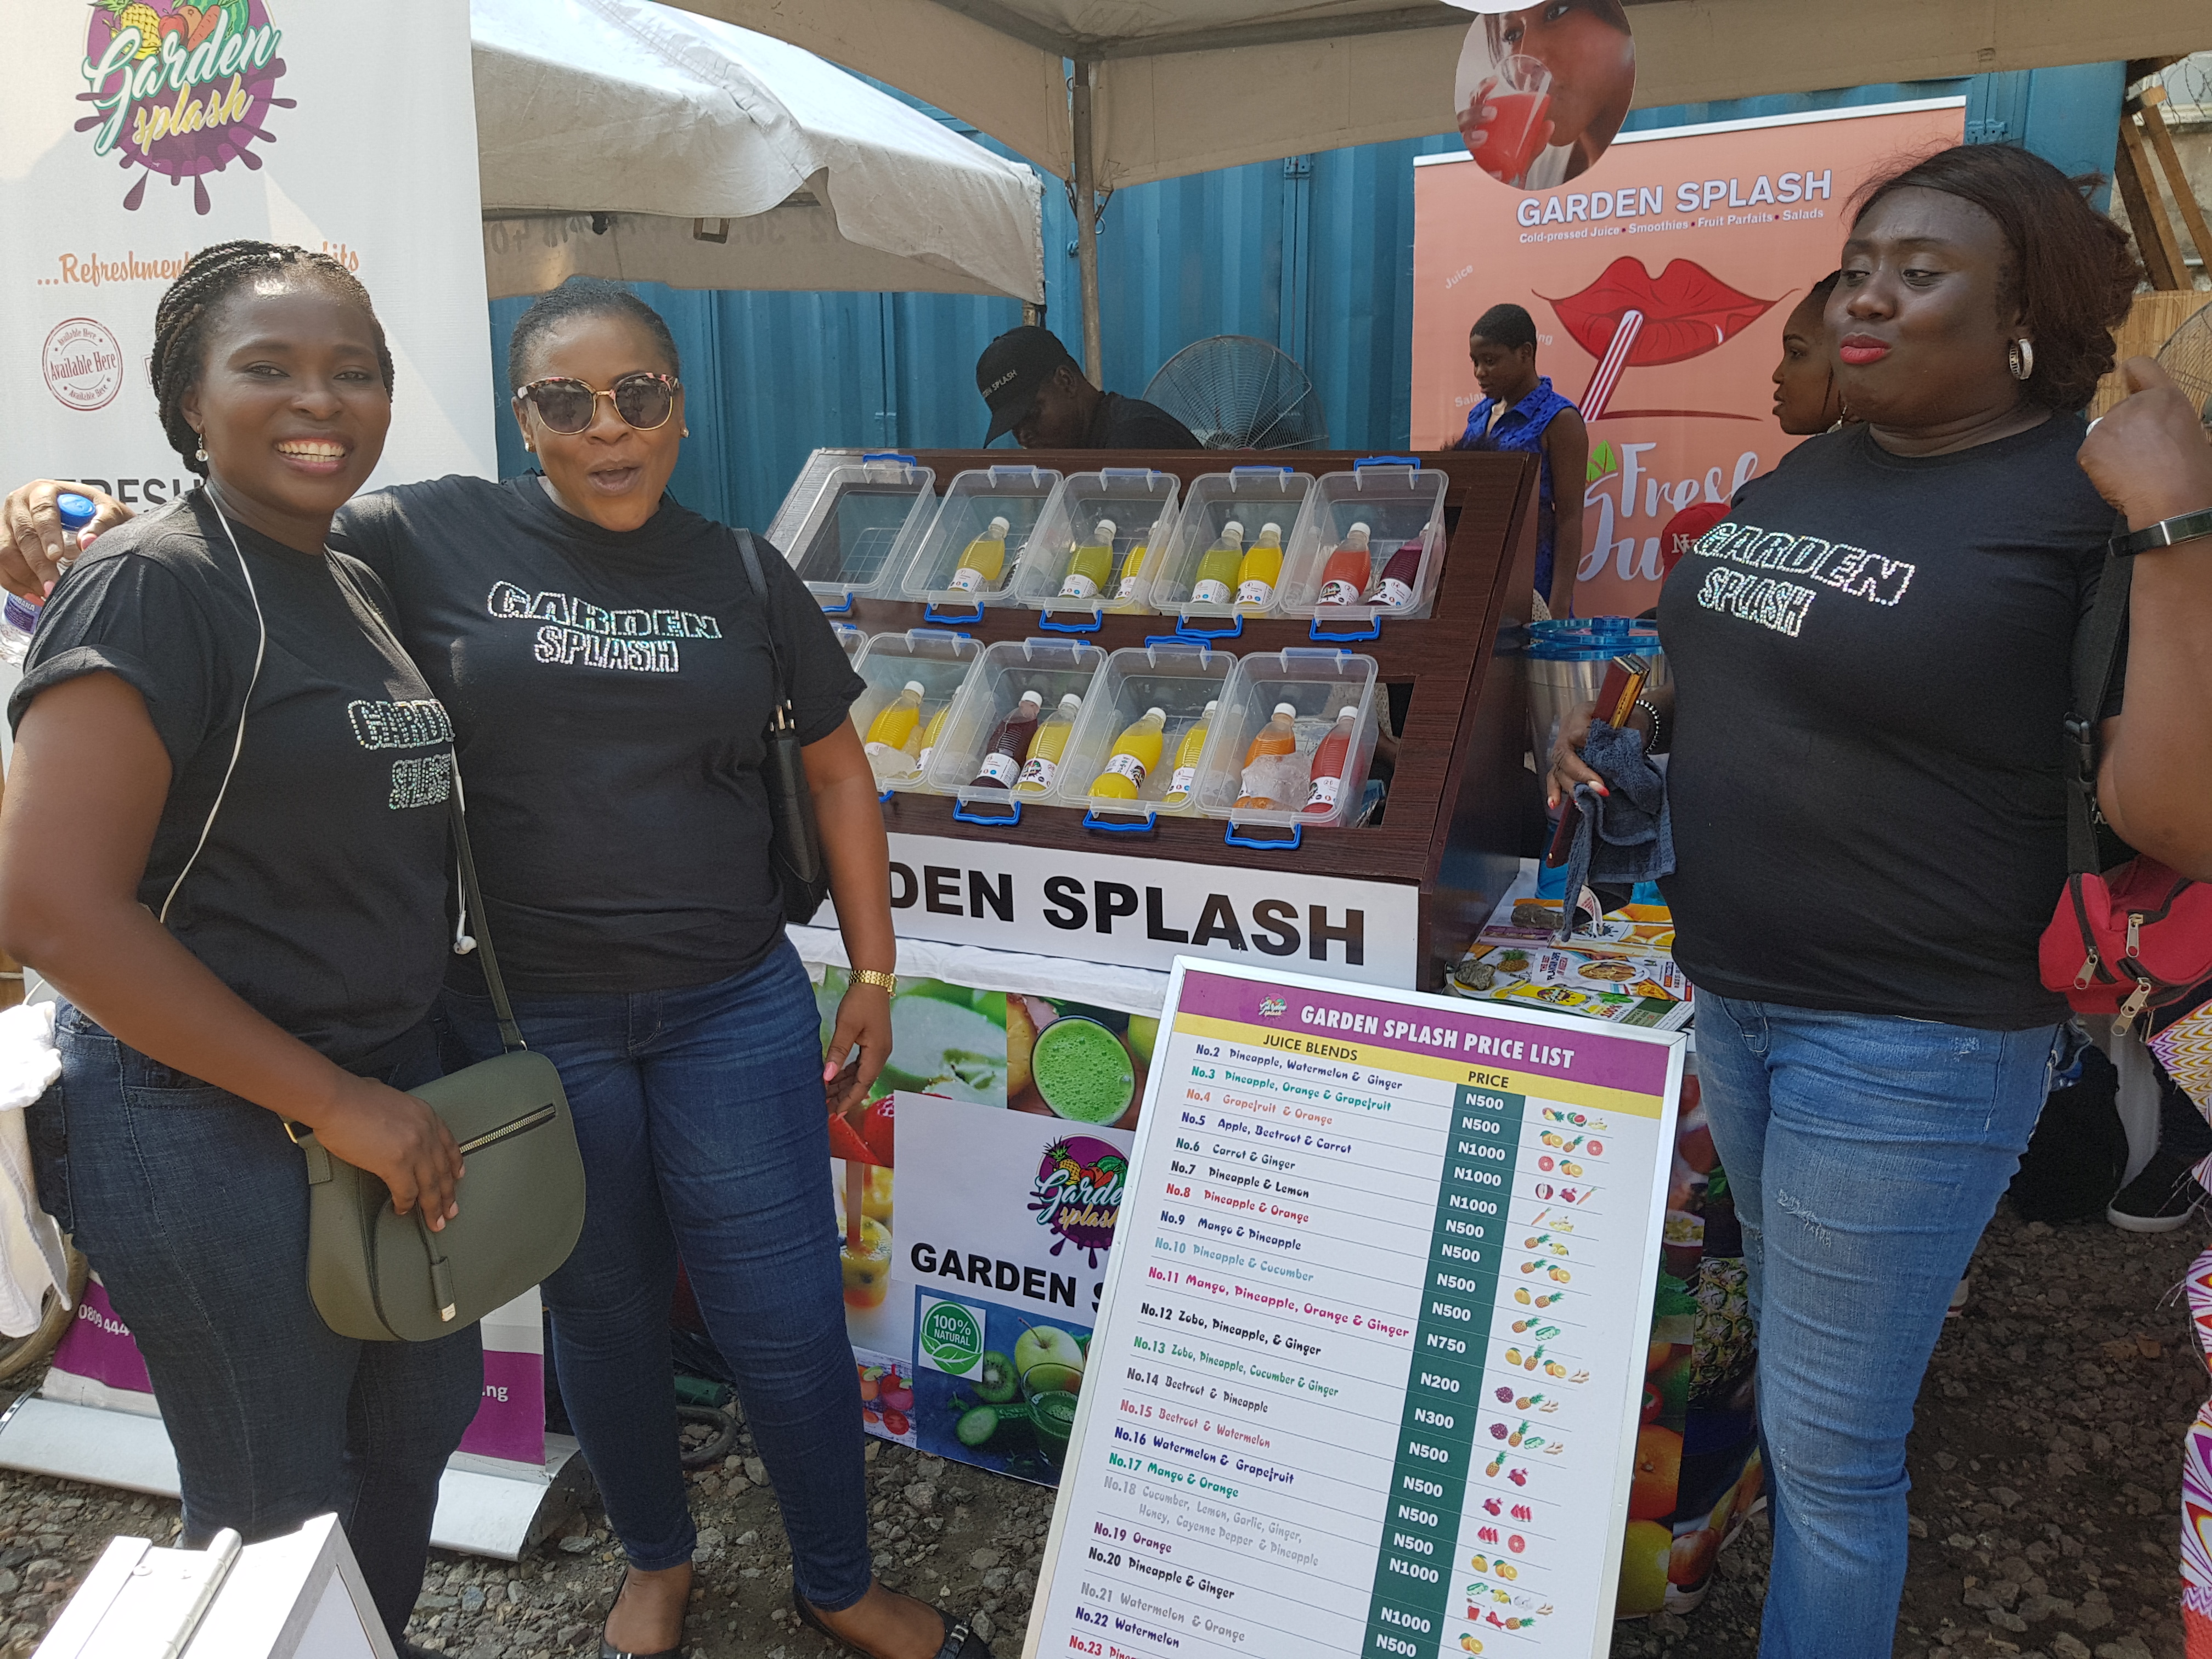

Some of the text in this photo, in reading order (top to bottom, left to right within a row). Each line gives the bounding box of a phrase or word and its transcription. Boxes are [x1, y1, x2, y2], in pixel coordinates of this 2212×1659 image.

[81, 7, 281, 156] Garden
[132, 72, 254, 155] splash
[1516, 169, 1832, 228] GARDEN SPLASH
[1519, 208, 1824, 244] Cold-pressed Juice Smoothies Fruit Parfaits Salads
[37, 251, 189, 286] ...Refreshmen
[1445, 264, 1474, 289] Juice
[50, 351, 116, 381] Available Here
[991, 370, 1017, 391] SPLASH
[1694, 522, 1915, 607] GARDEN
[488, 580, 723, 639] GARDEN
[1697, 566, 1816, 637] SPLASH
[534, 625, 680, 673] SPLASH
[890, 862, 1364, 966] DEN SPLASH
[1263, 1034, 1358, 1060] JUICE BLENDS
[1301, 1006, 1378, 1035] GARDEN
[1383, 1020, 1458, 1048] SPLASH
[1464, 1033, 1524, 1060] PRICE
[1530, 1045, 1575, 1069] LIST
[1196, 1044, 1402, 1090] No.2 Pineapple, Watermelon & Ginger
[1468, 1071, 1509, 1088] PRICE
[1187, 1089, 1333, 1125] No.4 Grapefruit & Orange
[1192, 1066, 1391, 1111] No.3 Pineapple, Orange & Grapefruit
[1466, 1093, 1503, 1111] N500
[1182, 1112, 1351, 1153] No.5 Apple, Beetroot & Carrot
[1458, 1141, 1505, 1161] N1000
[1176, 1138, 1295, 1170] No.6 Carrot & Ginger
[1171, 1161, 1309, 1198] No.7 Pineapple & Lemon
[1454, 1166, 1502, 1186] N1000
[1035, 1169, 1123, 1224] Garde
[1166, 1183, 1308, 1223] No.8 Pineapple & Orange
[1449, 1194, 1497, 1215] N1000
[1161, 1211, 1301, 1250] No.9 Mango & Pineapple
[911, 1242, 1076, 1308] GARDEN
[1155, 1237, 1314, 1282] No.10 Pineapple & Cucumber
[1149, 1267, 1409, 1338] No.11 Mango, Pineapple, Orange & Ginger
[933, 1315, 971, 1336] 100%
[934, 1329, 970, 1346] NATURAL
[1141, 1303, 1321, 1355] No.12 Zobo, Pineapple, & Ginger
[1427, 1333, 1466, 1353] N750
[1134, 1336, 1339, 1397] No.13 Zobo, Pineapple, Cucumber & Ginger
[1420, 1372, 1460, 1393] N200
[482, 1385, 508, 1402] .ng
[1127, 1368, 1268, 1413] No.14 Beetroot & Pineapple
[1121, 1399, 1271, 1449] No.15 Beetroot & Watermelon
[1415, 1408, 1454, 1429] N300
[1109, 1453, 1239, 1498] No.17 Mango & Orange
[1115, 1427, 1294, 1484] No.16 Watermelon & Grapefruit
[1104, 1476, 1302, 1544] No.18 Cucumber, Lemon, Garlic, Ginger,
[1094, 1522, 1172, 1553] No.19 Orange
[1139, 1504, 1318, 1566] Honey, Cayenne Pepper & Pineapple
[1088, 1547, 1234, 1599] No.20 Pineapple & Ginger
[1389, 1558, 1439, 1583] N1000
[1076, 1607, 1180, 1648] No.22 Watermelon
[1081, 1582, 1245, 1642] No.21 Watermelon & Orange
[1381, 1607, 1430, 1633] N1000
[1069, 1635, 1102, 1656] No.23
[1376, 1634, 1417, 1657] N500
